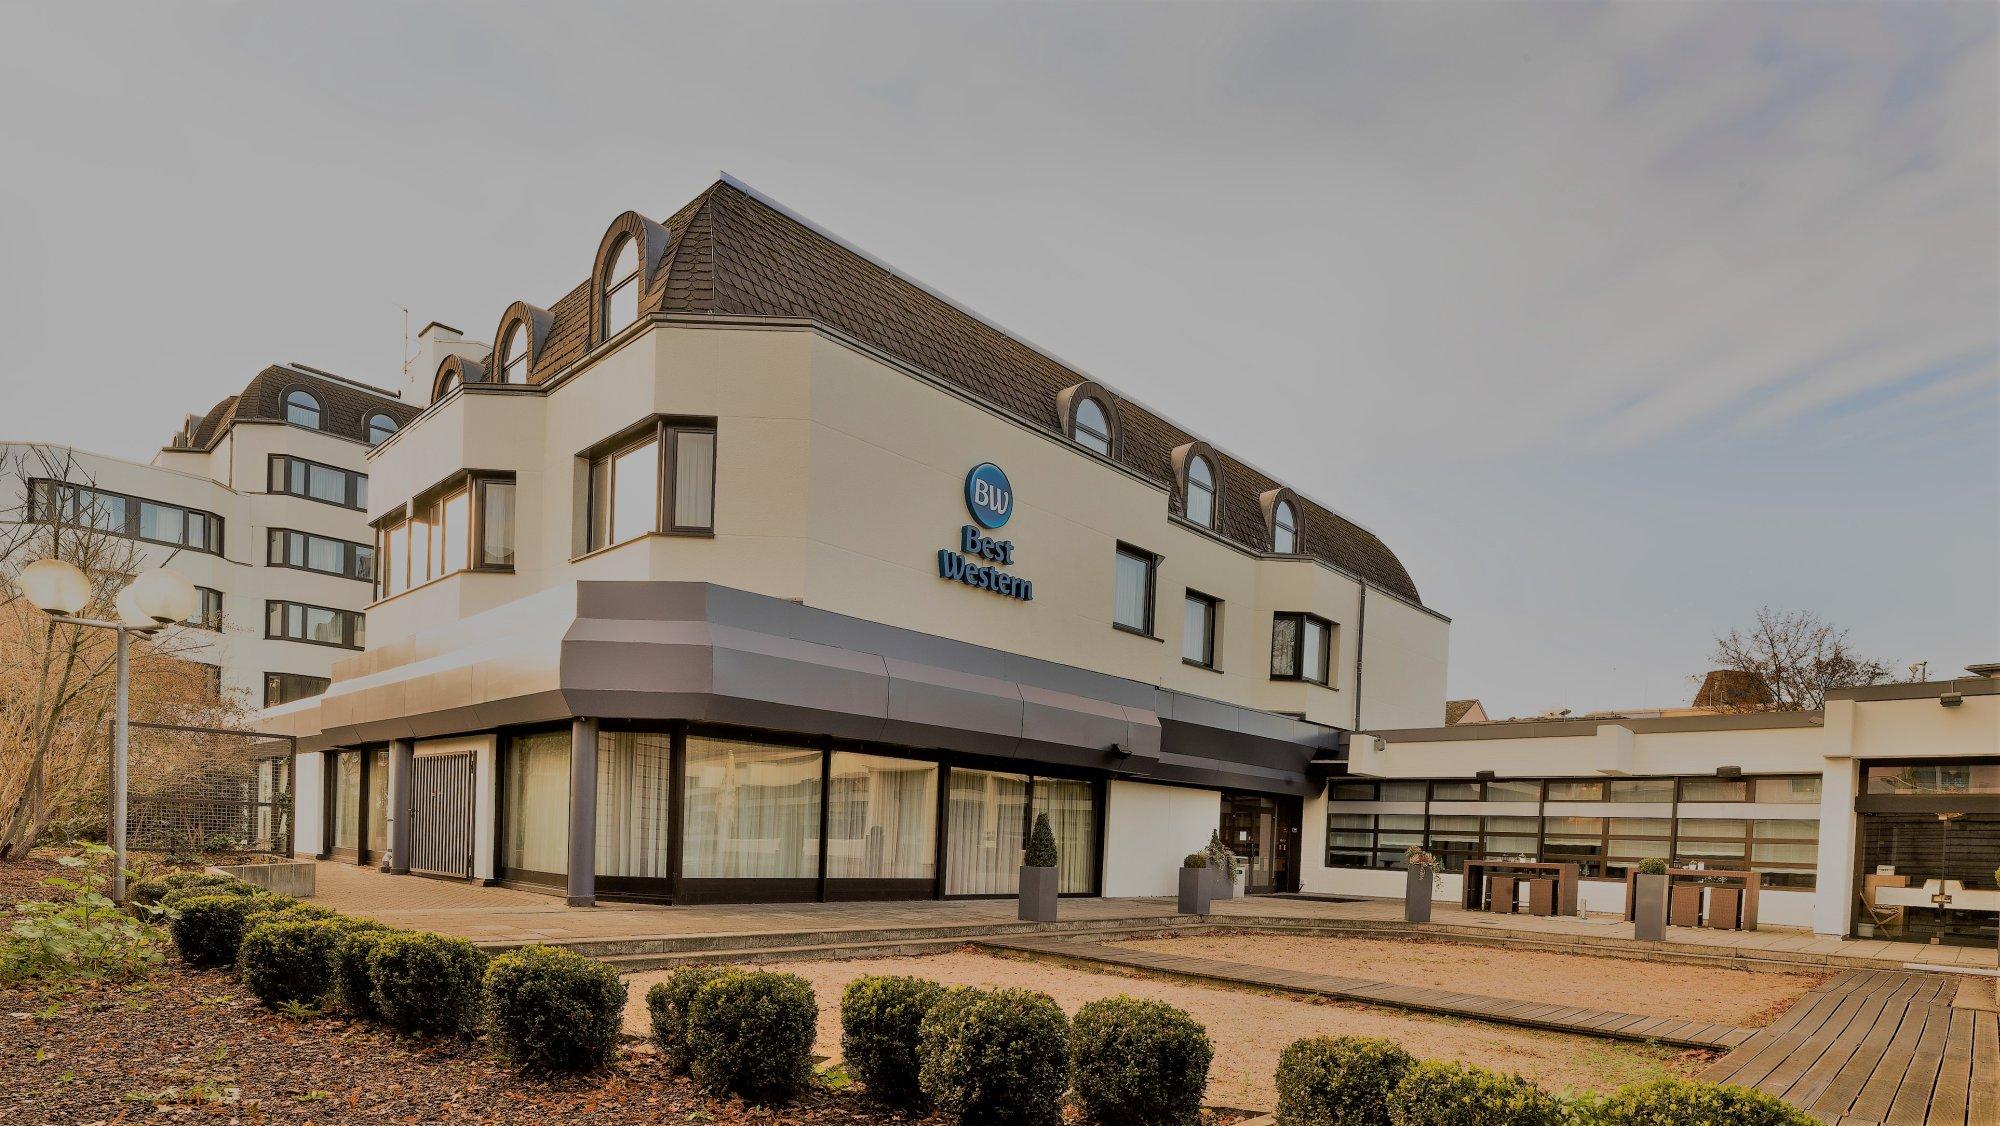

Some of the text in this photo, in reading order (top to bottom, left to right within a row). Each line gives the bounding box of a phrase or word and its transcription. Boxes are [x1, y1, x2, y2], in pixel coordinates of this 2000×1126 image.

[974, 478, 1009, 515] BW
[961, 525, 1014, 565] Best
[938, 549, 1033, 601] Western
